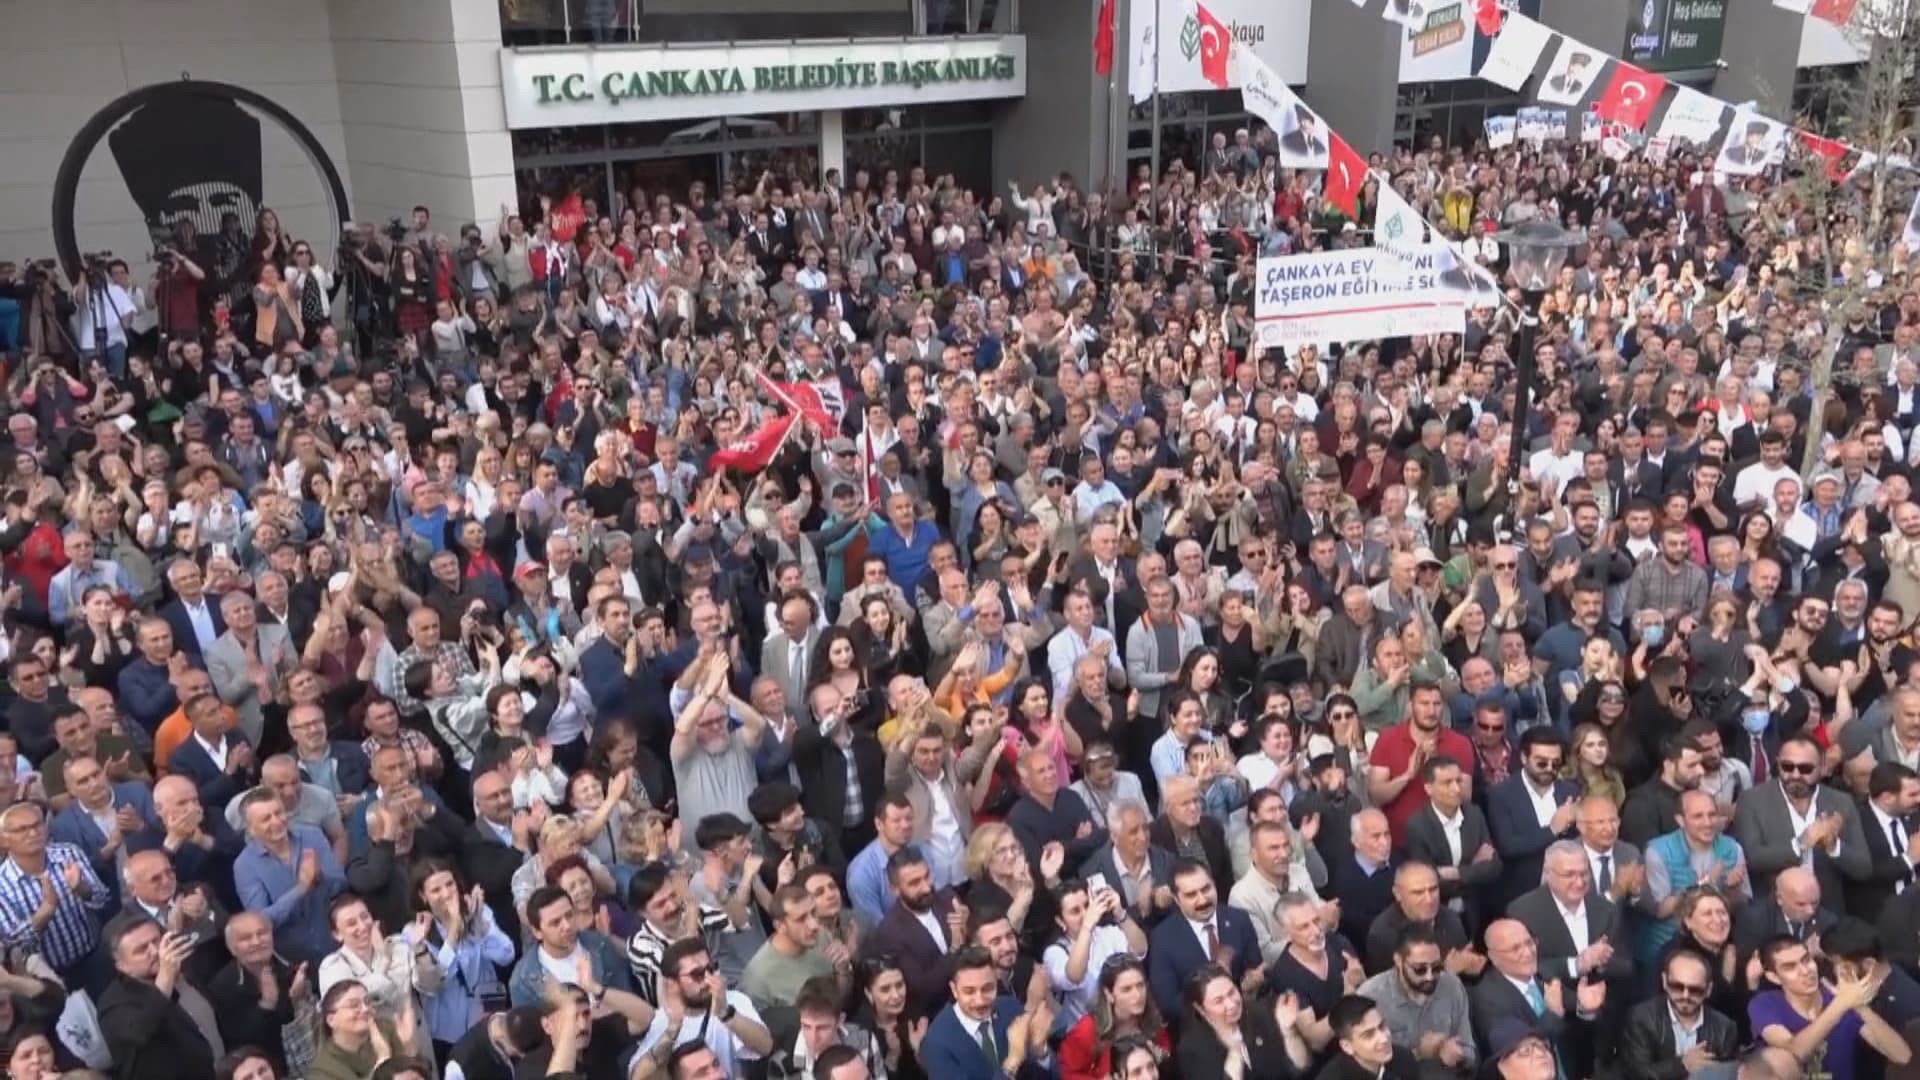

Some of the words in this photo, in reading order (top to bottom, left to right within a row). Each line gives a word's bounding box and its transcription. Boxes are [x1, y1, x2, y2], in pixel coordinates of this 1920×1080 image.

[1673, 1, 1690, 21] Hoş
[1691, 1, 1723, 19] Geldiniz
[1228, 18, 1265, 47] kaya
[1670, 30, 1698, 48] Masası
[533, 72, 593, 104] T.C.
[601, 67, 746, 106] ÇANKAYA
[752, 56, 877, 90] BELEDİYE
[882, 54, 1016, 88] BAŞKANLIĞI
[1266, 261, 1345, 288] ÇANKAYA
[1260, 283, 1337, 307] TAŞERON
